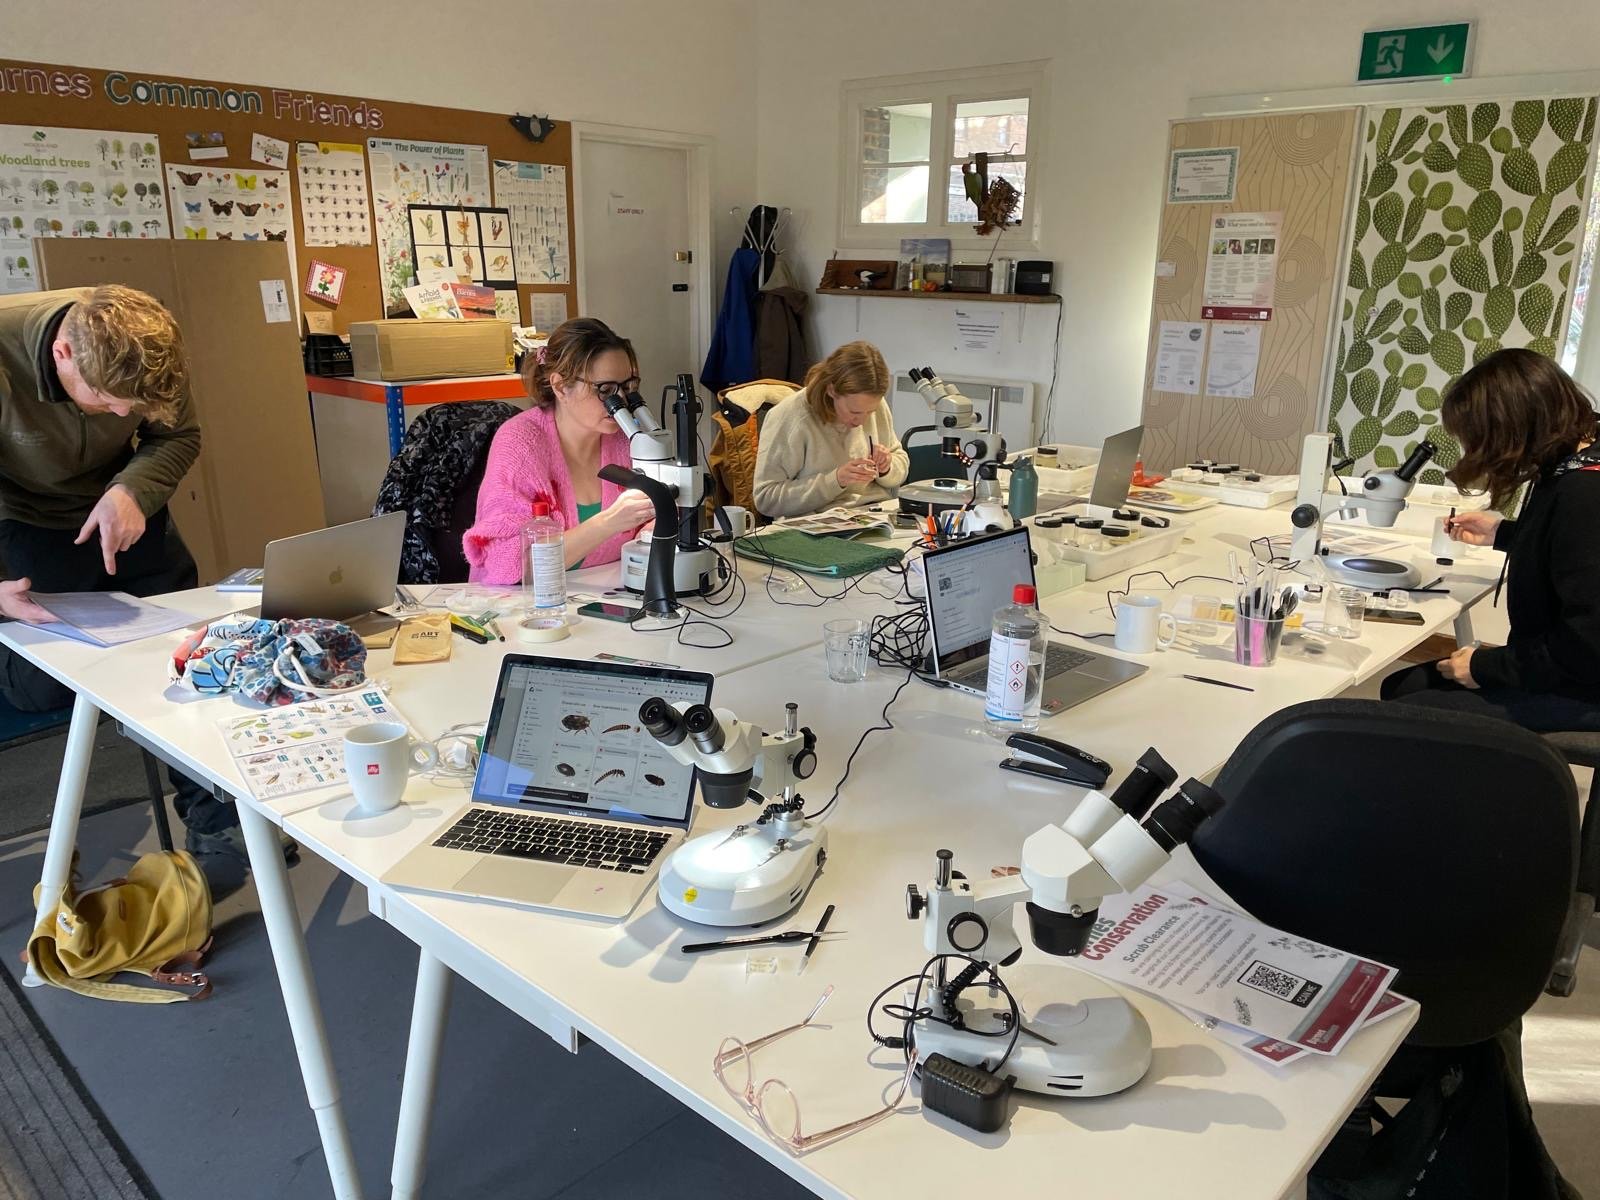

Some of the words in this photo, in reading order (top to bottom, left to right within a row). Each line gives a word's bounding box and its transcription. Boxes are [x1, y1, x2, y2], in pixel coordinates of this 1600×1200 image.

[0, 67, 93, 99] rnes
[103, 72, 262, 115] Common
[272, 88, 384, 131] Friends
[59, 156, 91, 168] trees
[395, 143, 409, 152] The
[410, 144, 433, 154] Power
[434, 145, 442, 155] of
[443, 146, 465, 156] Plants
[1081, 894, 1169, 961] Conservation
[1122, 942, 1150, 963] Scrub
[1142, 915, 1181, 945] Clearance
[1296, 990, 1312, 1005] SCAN
